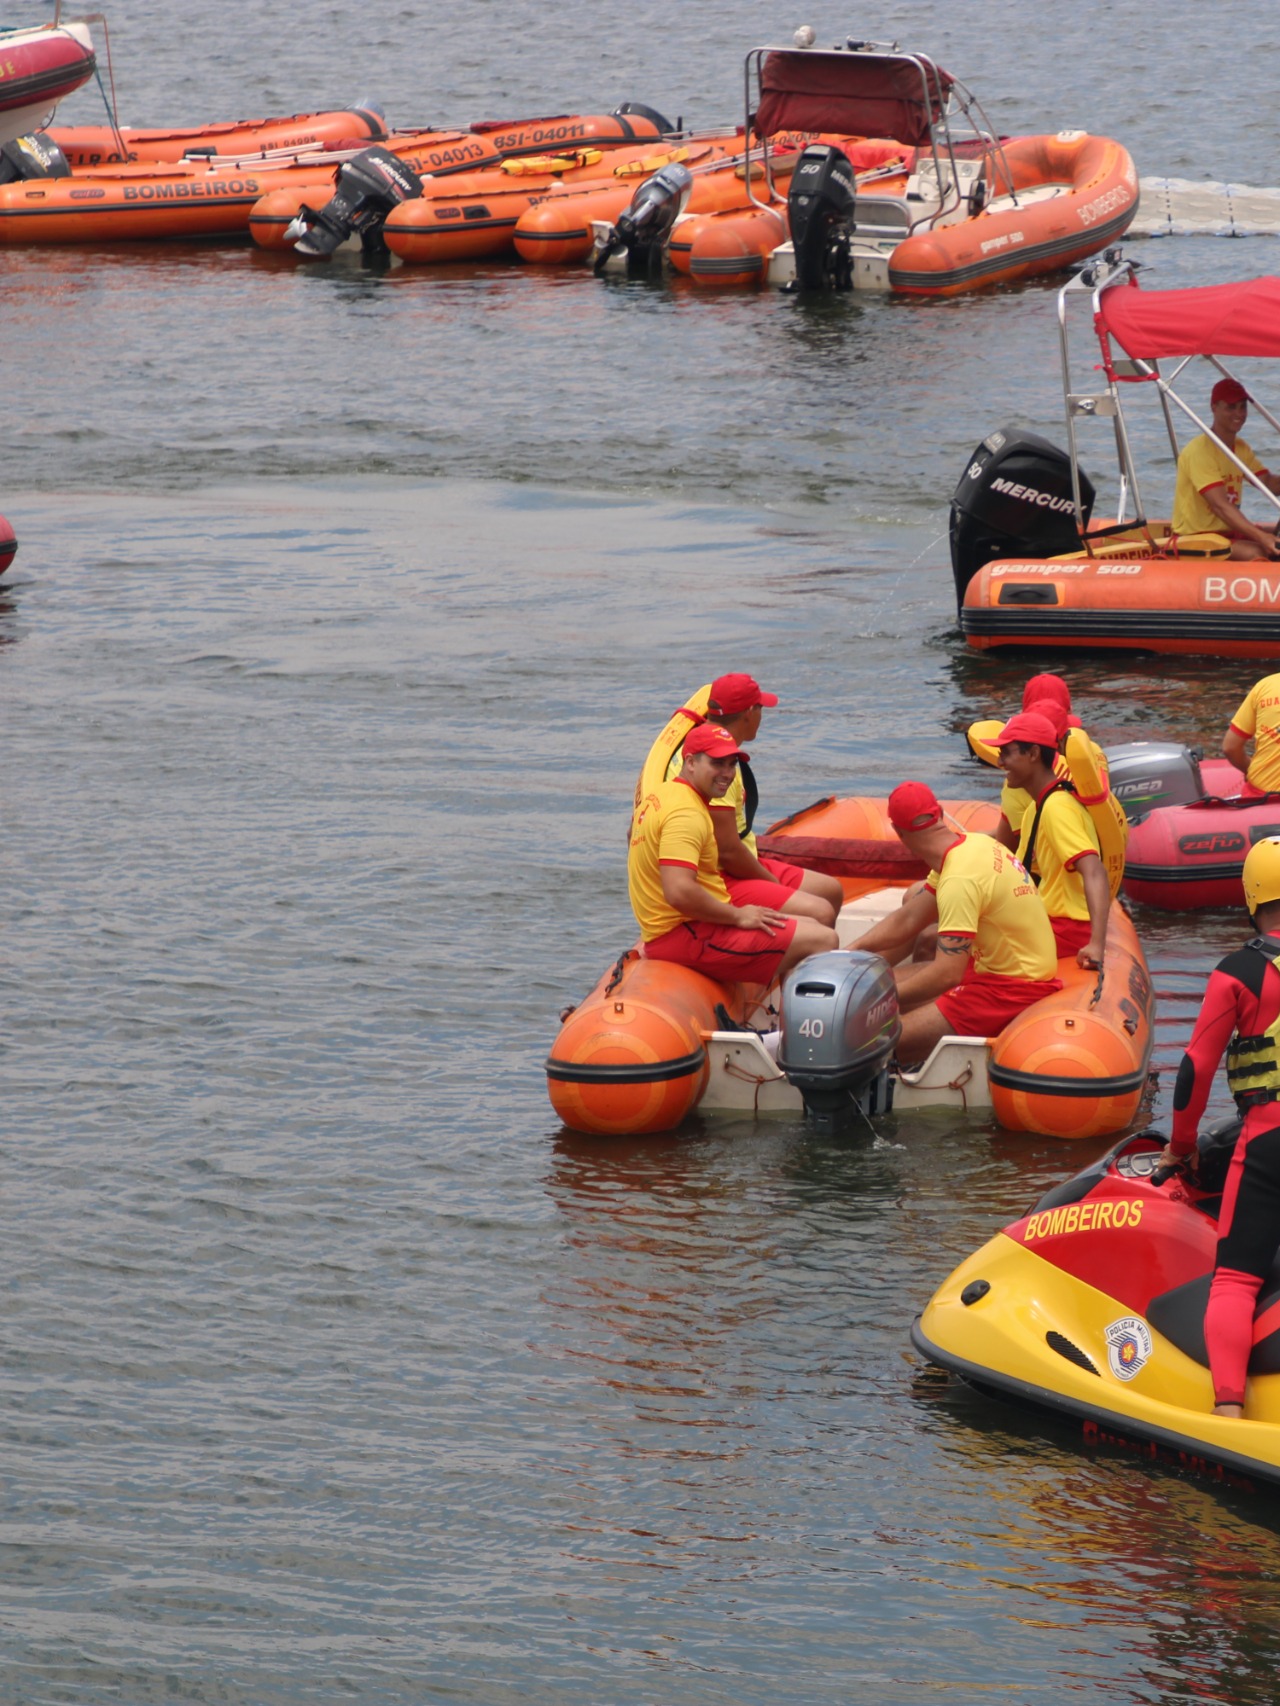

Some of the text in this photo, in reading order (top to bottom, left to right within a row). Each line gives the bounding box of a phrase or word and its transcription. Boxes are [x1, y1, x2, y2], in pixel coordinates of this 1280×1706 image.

[494, 124, 586, 150] BSI-04011
[403, 144, 484, 171] SI-04013
[800, 163, 820, 175] 50
[123, 179, 259, 200] BOMBEIROS
[967, 461, 982, 480] 50
[990, 477, 1088, 516] MERCURY
[990, 563, 1142, 577] gamper 500
[1182, 834, 1242, 853] zefir
[798, 1018, 825, 1039] 40
[1024, 1200, 1144, 1241] BOMBEIROS
